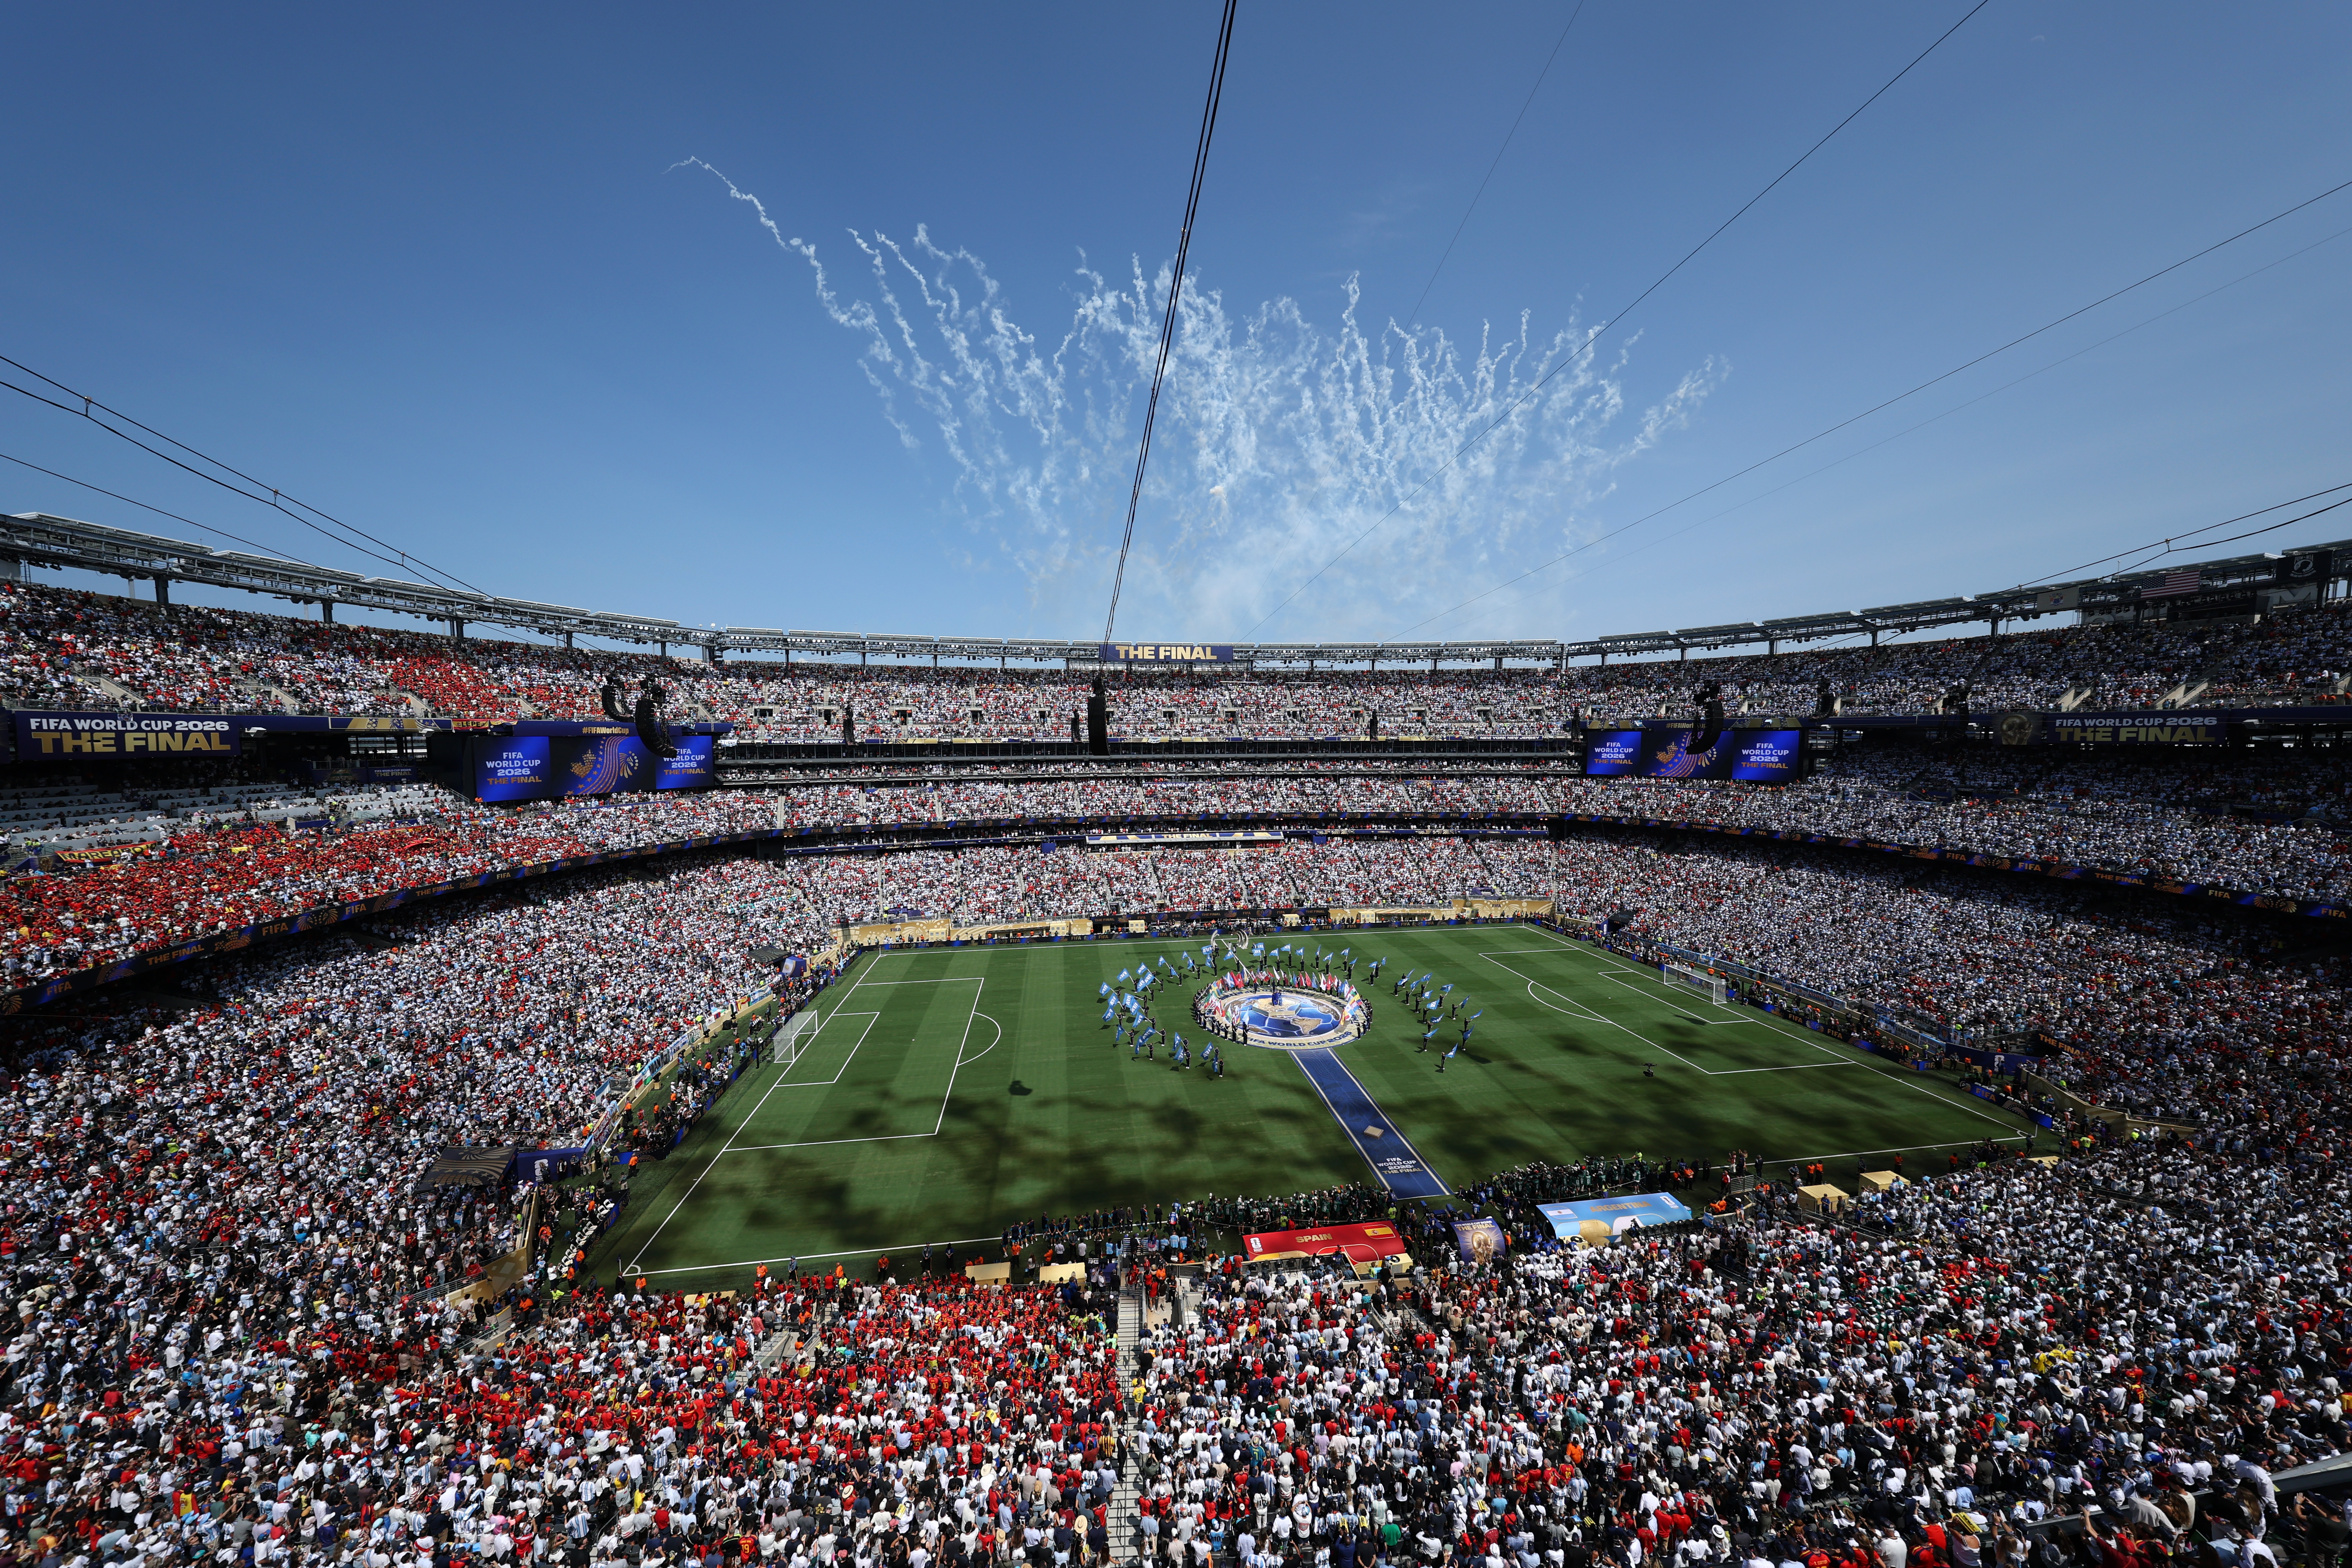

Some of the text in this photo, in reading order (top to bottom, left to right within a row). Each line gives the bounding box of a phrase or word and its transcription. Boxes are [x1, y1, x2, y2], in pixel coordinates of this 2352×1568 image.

[1115, 646, 1217, 660] THE FINAL
[30, 719, 229, 731] FIFA WORLD CUP 2026
[2134, 718, 2163, 726] CUP
[2166, 717, 2218, 726] 2026
[2055, 727, 2215, 742] THE FINAL
[32, 732, 231, 753] THE FINAL
[2019, 862, 2042, 871] FIFA
[2116, 875, 2145, 885] FINAL
[2209, 889, 2230, 898] FIFA
[346, 904, 366, 915] FIFA
[2322, 908, 2347, 918] FIFA
[263, 922, 288, 936] FIFA
[147, 945, 204, 965] THE FINAL
[47, 981, 72, 996] FIFA
[1789, 1014, 1802, 1023] FIFA
[1327, 1031, 1352, 1044] 2026
[1827, 1029, 1843, 1039] FIFA
[2039, 1033, 2082, 1055] THE FINA
[715, 1087, 724, 1100] FIFA
[1976, 1087, 1996, 1102] FIFA
[691, 1111, 702, 1125] FIFA
[1590, 1201, 1652, 1212] ARGENTINA
[603, 1210, 617, 1230] FIFA
[1296, 1233, 1332, 1243] SPAIN
[659, 1448, 666, 1459] 10
[742, 1544, 749, 1553] 19
